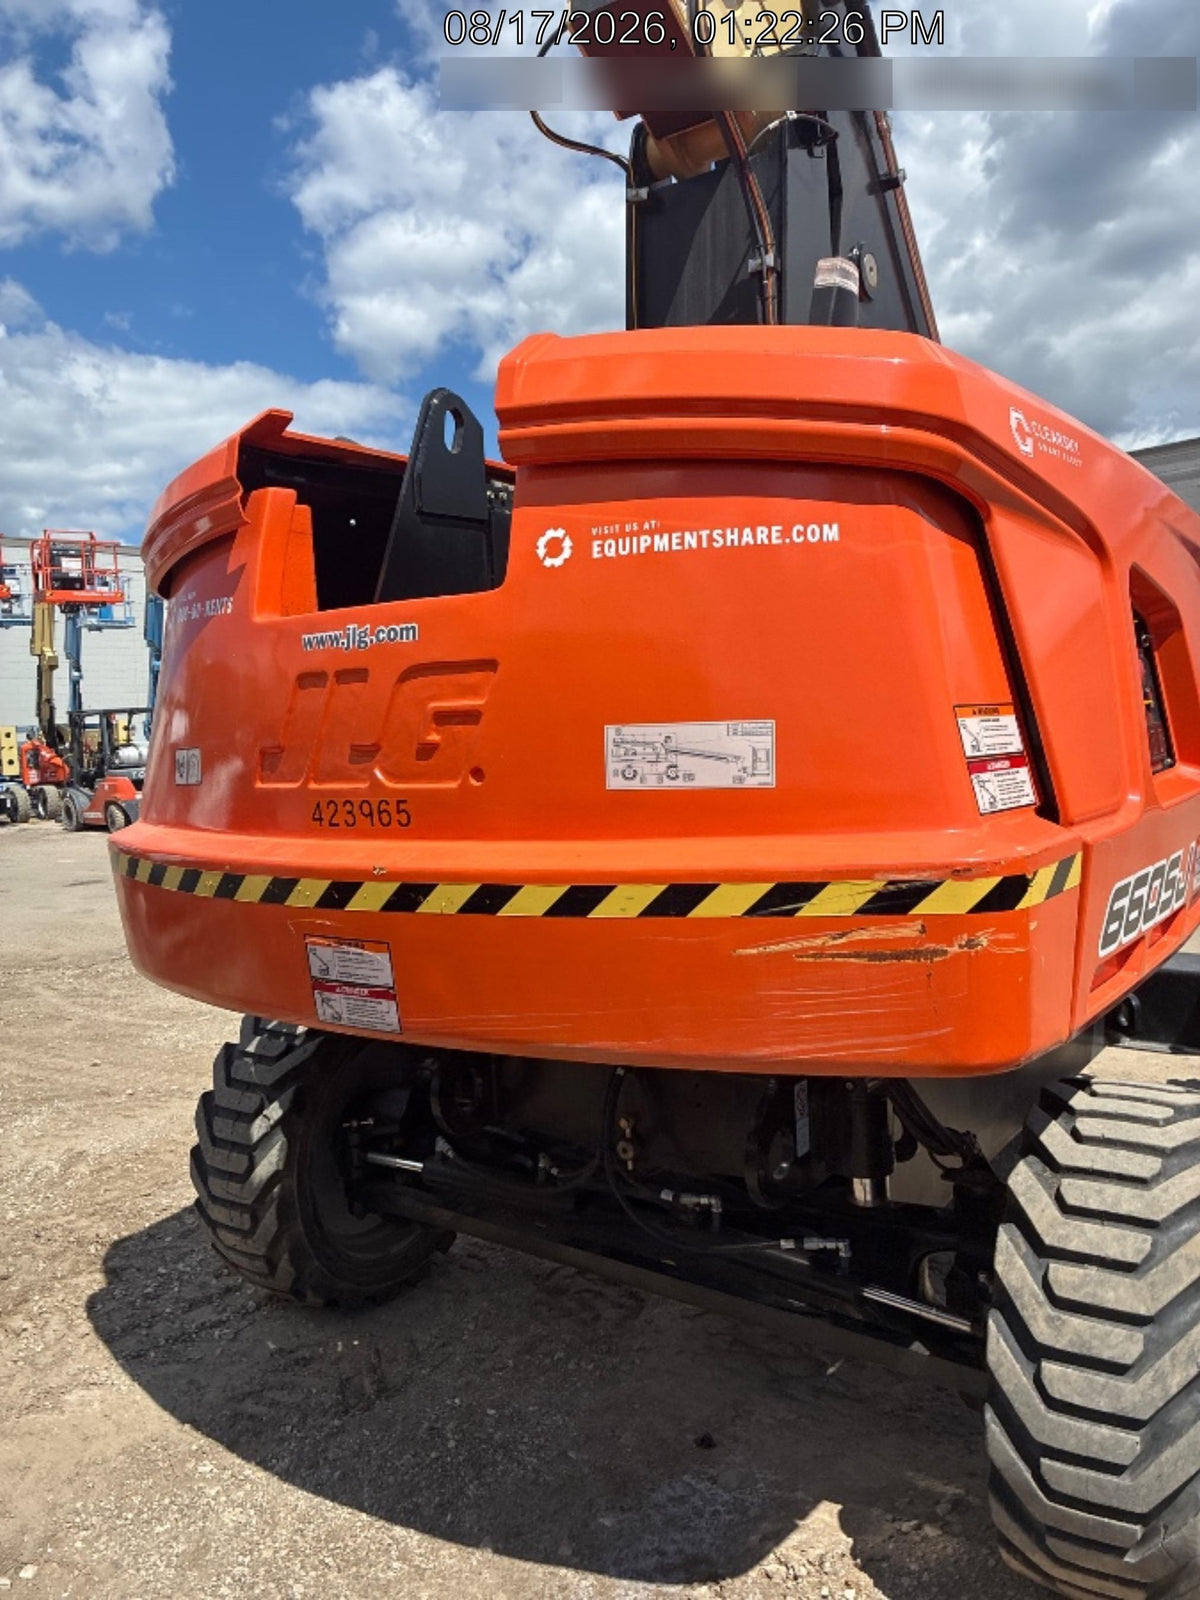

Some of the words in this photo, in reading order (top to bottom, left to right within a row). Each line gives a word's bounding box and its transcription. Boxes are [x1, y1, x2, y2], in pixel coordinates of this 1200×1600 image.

[591, 524, 620, 536] VISIT
[625, 522, 639, 533] US
[592, 523, 840, 559] EQUIPMENTSHARE.COM
[302, 623, 418, 652] www.jlg.com
[253, 658, 498, 789] JLG
[311, 799, 412, 828] 423965
